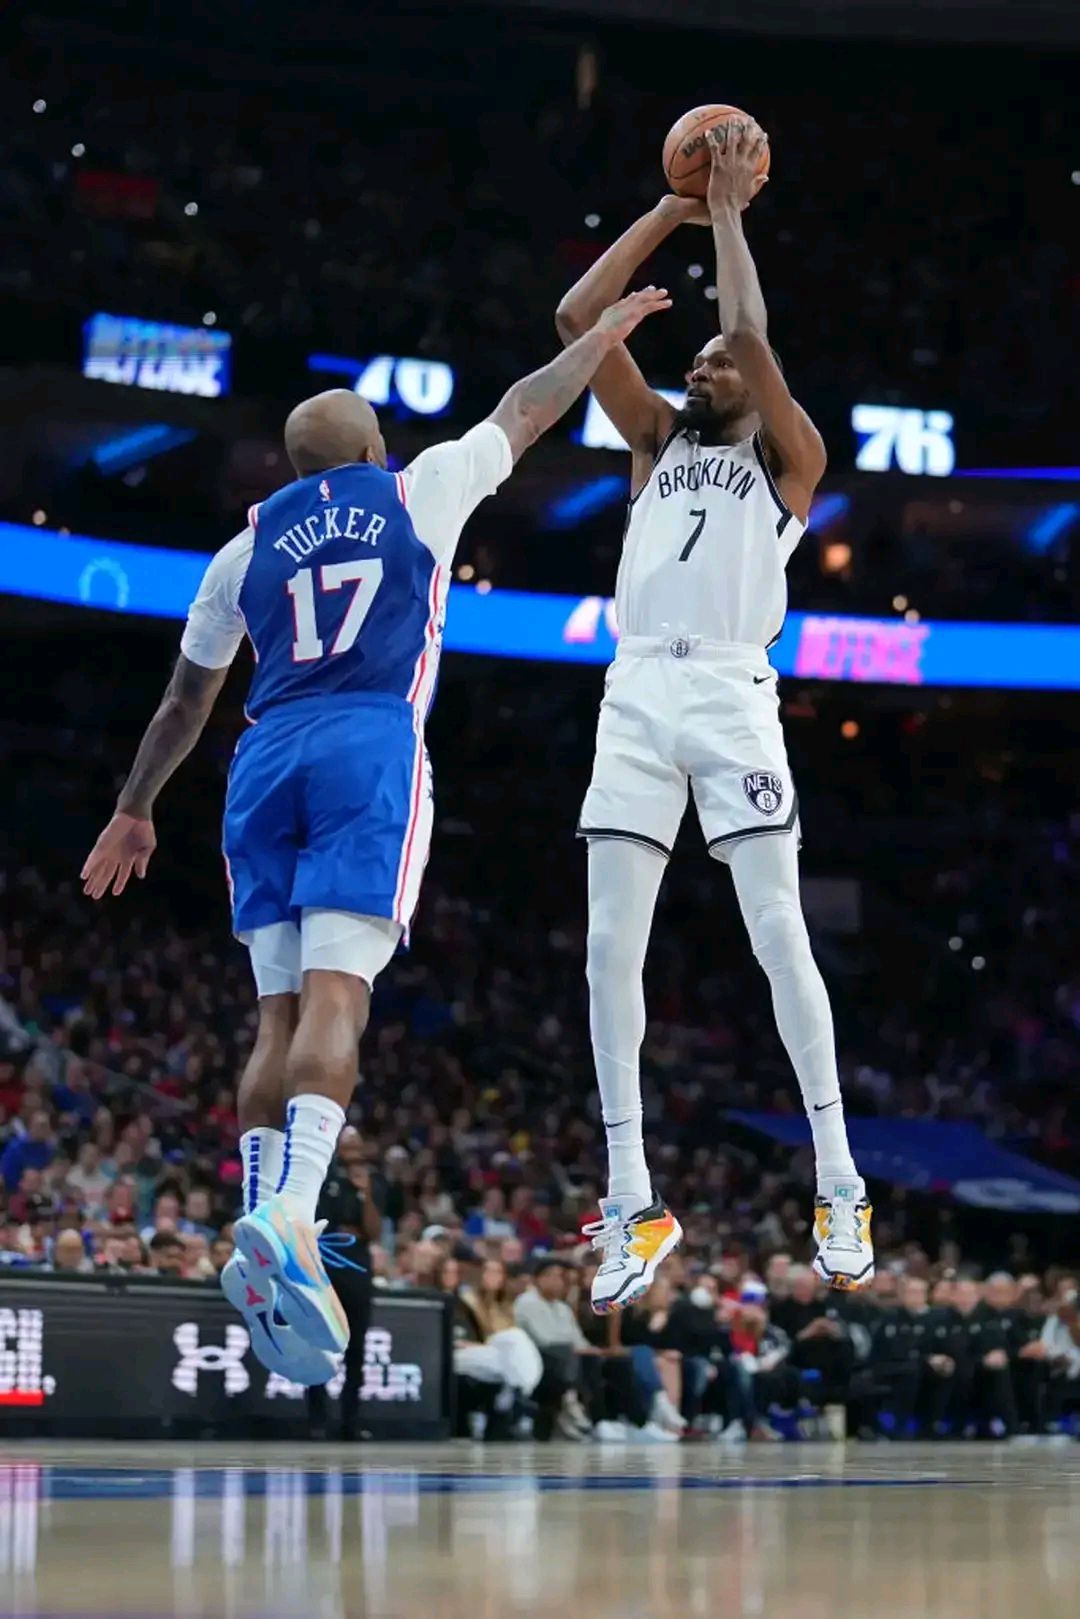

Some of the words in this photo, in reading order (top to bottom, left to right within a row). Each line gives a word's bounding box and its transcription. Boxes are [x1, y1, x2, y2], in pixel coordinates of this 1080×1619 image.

[273, 507, 387, 563] TUCKER
[678, 508, 707, 562] 7
[286, 557, 384, 663] 17
[746, 774, 783, 794] NETS
